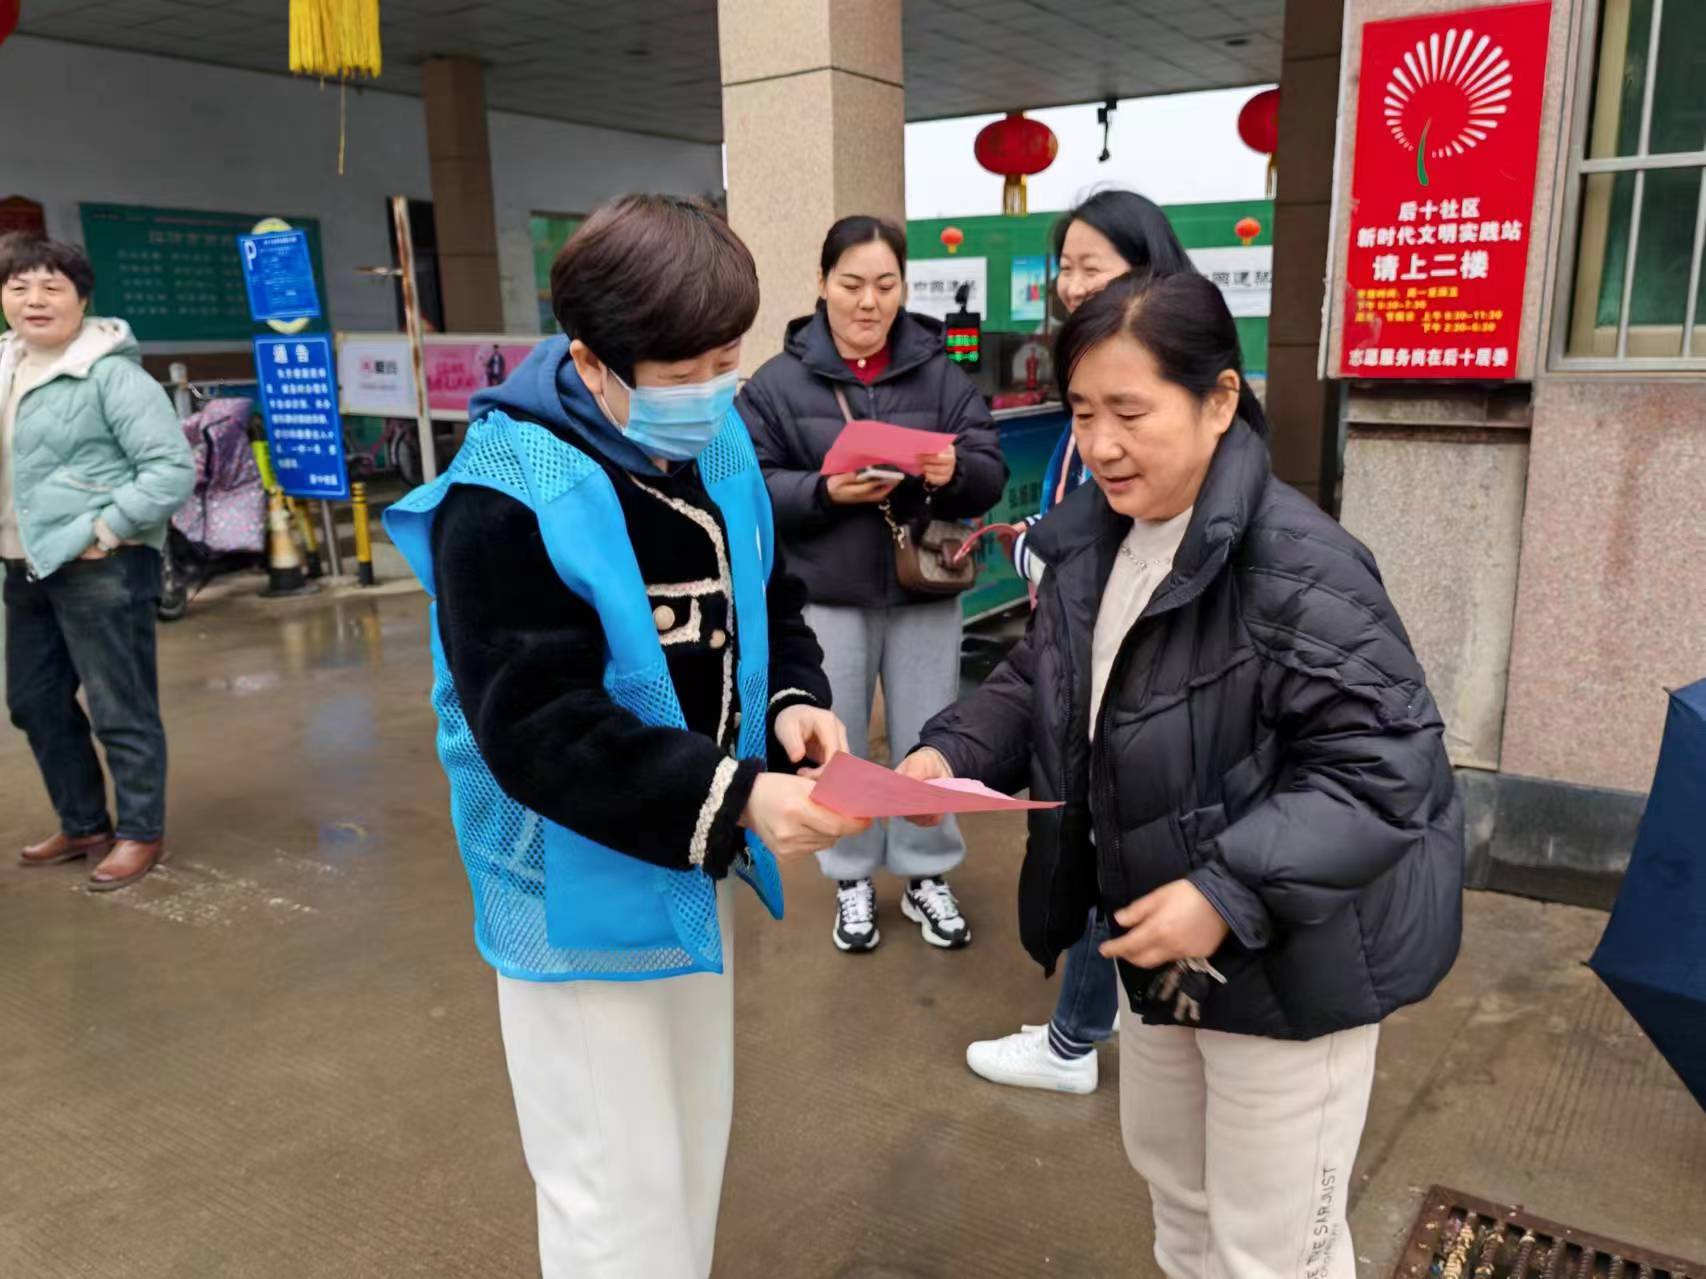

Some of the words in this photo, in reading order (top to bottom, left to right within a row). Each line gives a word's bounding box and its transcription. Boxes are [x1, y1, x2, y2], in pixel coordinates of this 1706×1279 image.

[1398, 197, 1480, 221] 后十社区
[1357, 220, 1522, 248] 新时代文明实践站
[244, 240, 257, 271] P
[1372, 250, 1489, 282] 请上二楼
